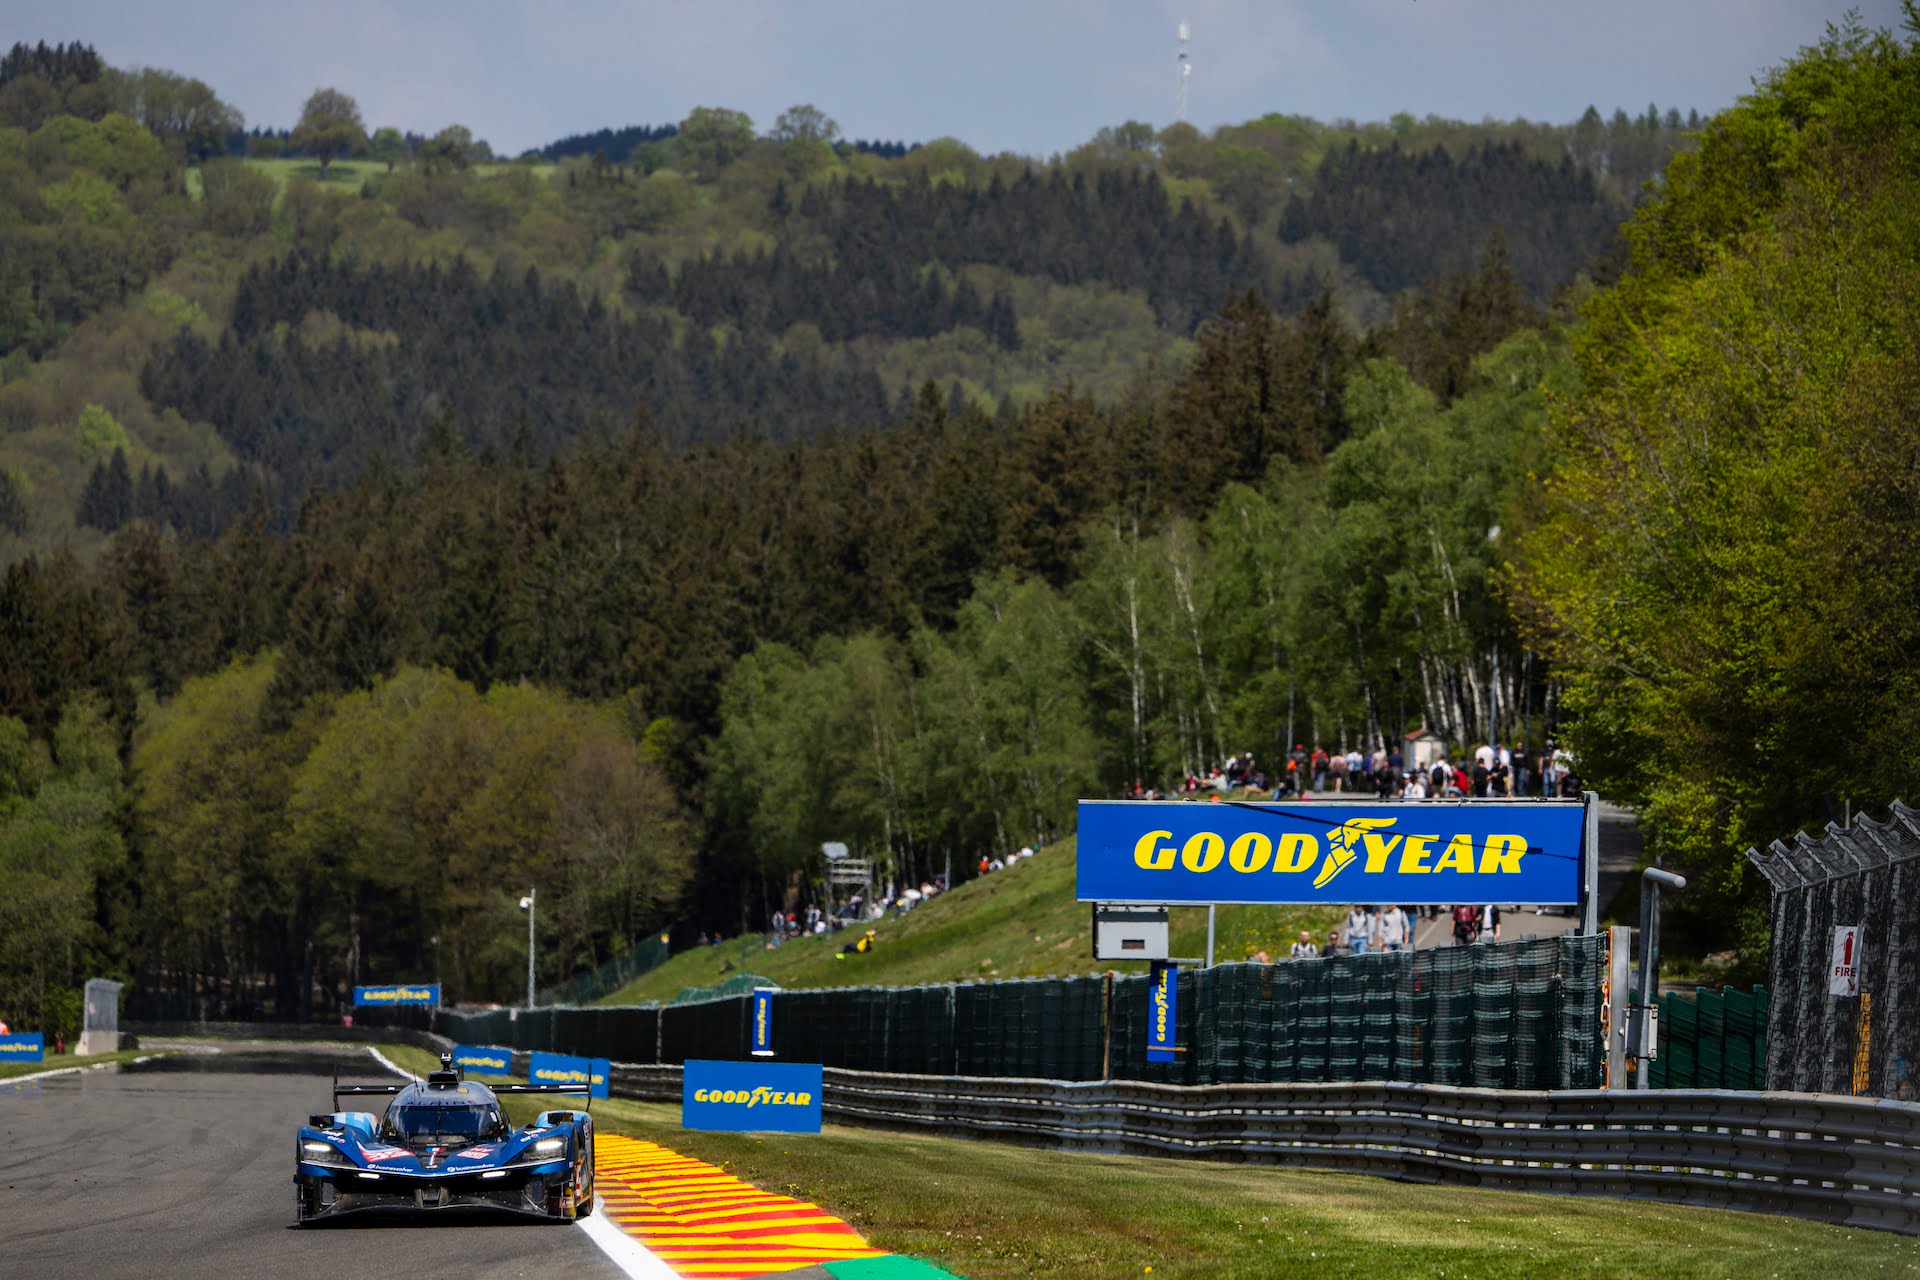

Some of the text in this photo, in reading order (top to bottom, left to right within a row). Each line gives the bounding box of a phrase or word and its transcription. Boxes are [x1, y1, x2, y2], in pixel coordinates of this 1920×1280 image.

[1134, 826, 1527, 876] GOODYEAR
[1835, 967, 1857, 976] FIRE
[1156, 968, 1169, 1042] GOODYEAR
[694, 1088, 811, 1106] GOODYEAR
